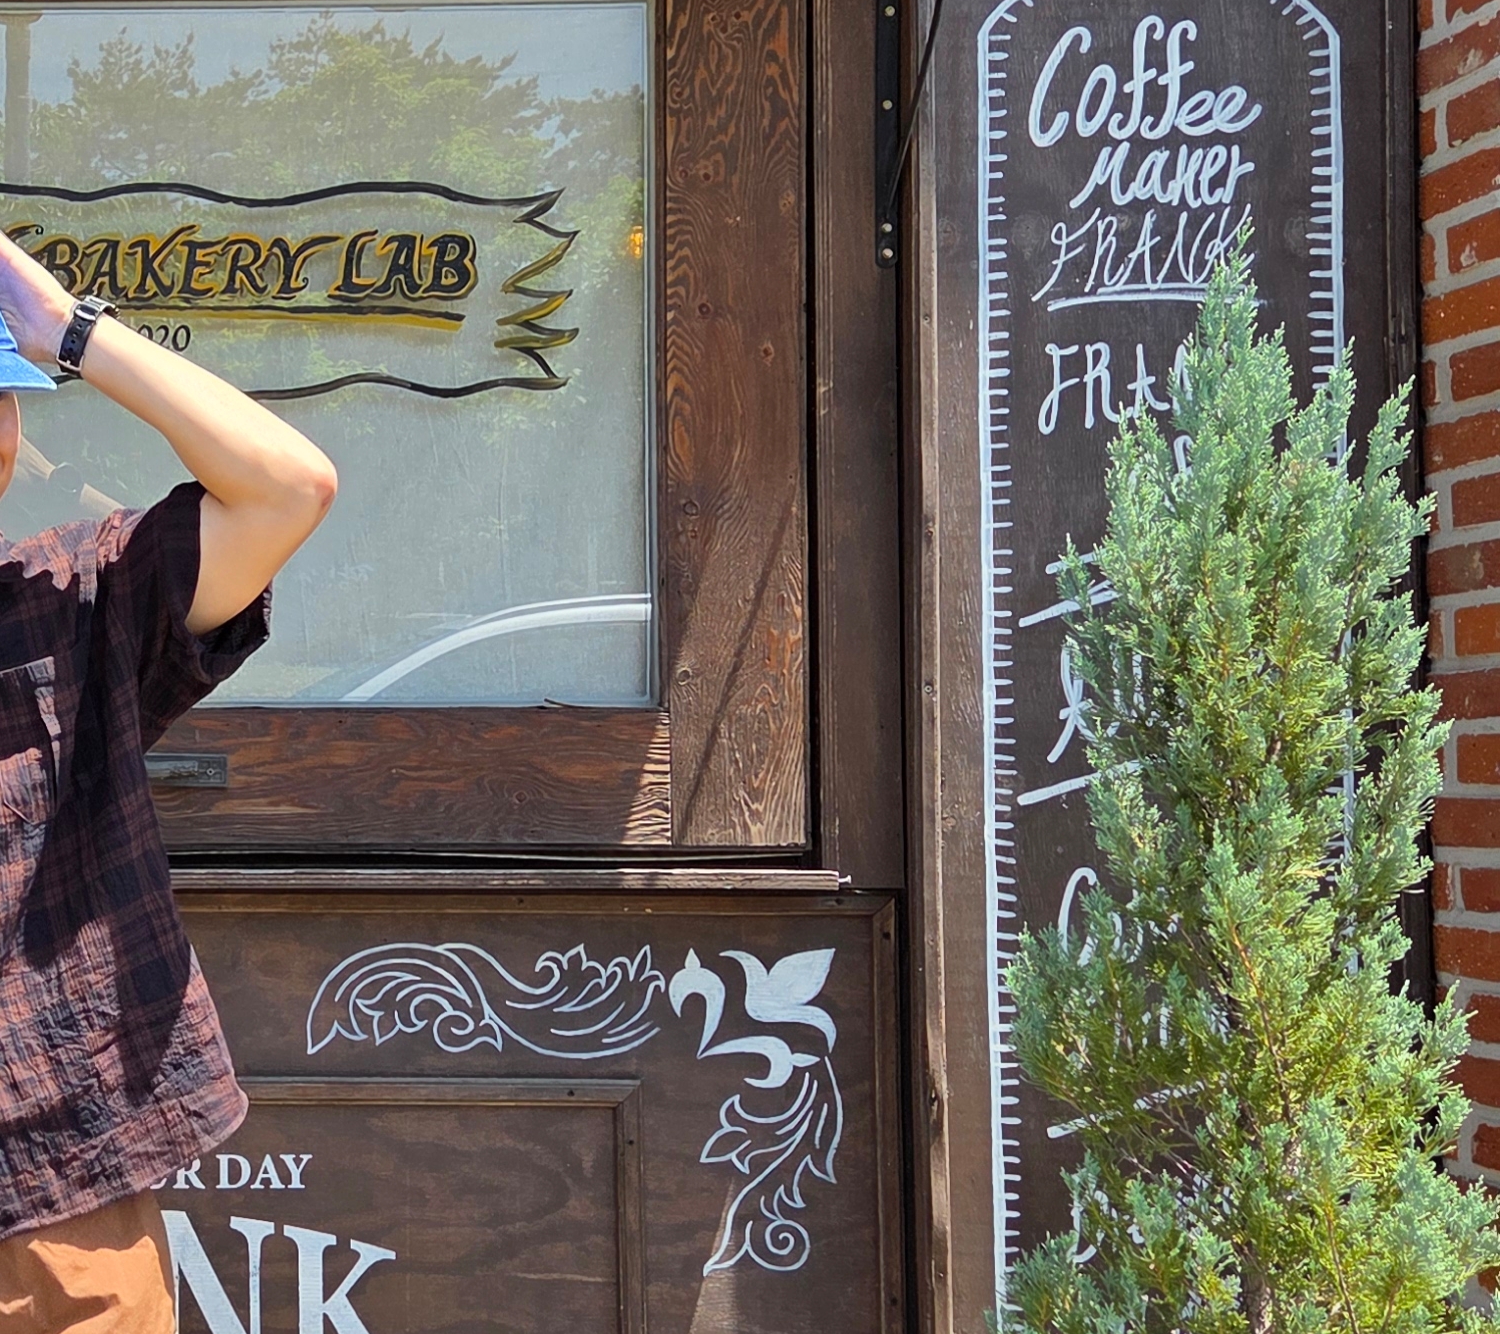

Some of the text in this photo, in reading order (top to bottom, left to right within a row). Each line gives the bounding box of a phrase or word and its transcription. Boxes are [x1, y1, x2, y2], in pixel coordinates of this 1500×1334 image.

[1028, 15, 1262, 148] Coffee
[31, 224, 345, 301] BAKERY
[328, 230, 478, 300] LAB
[215, 1154, 313, 1190] DAY
